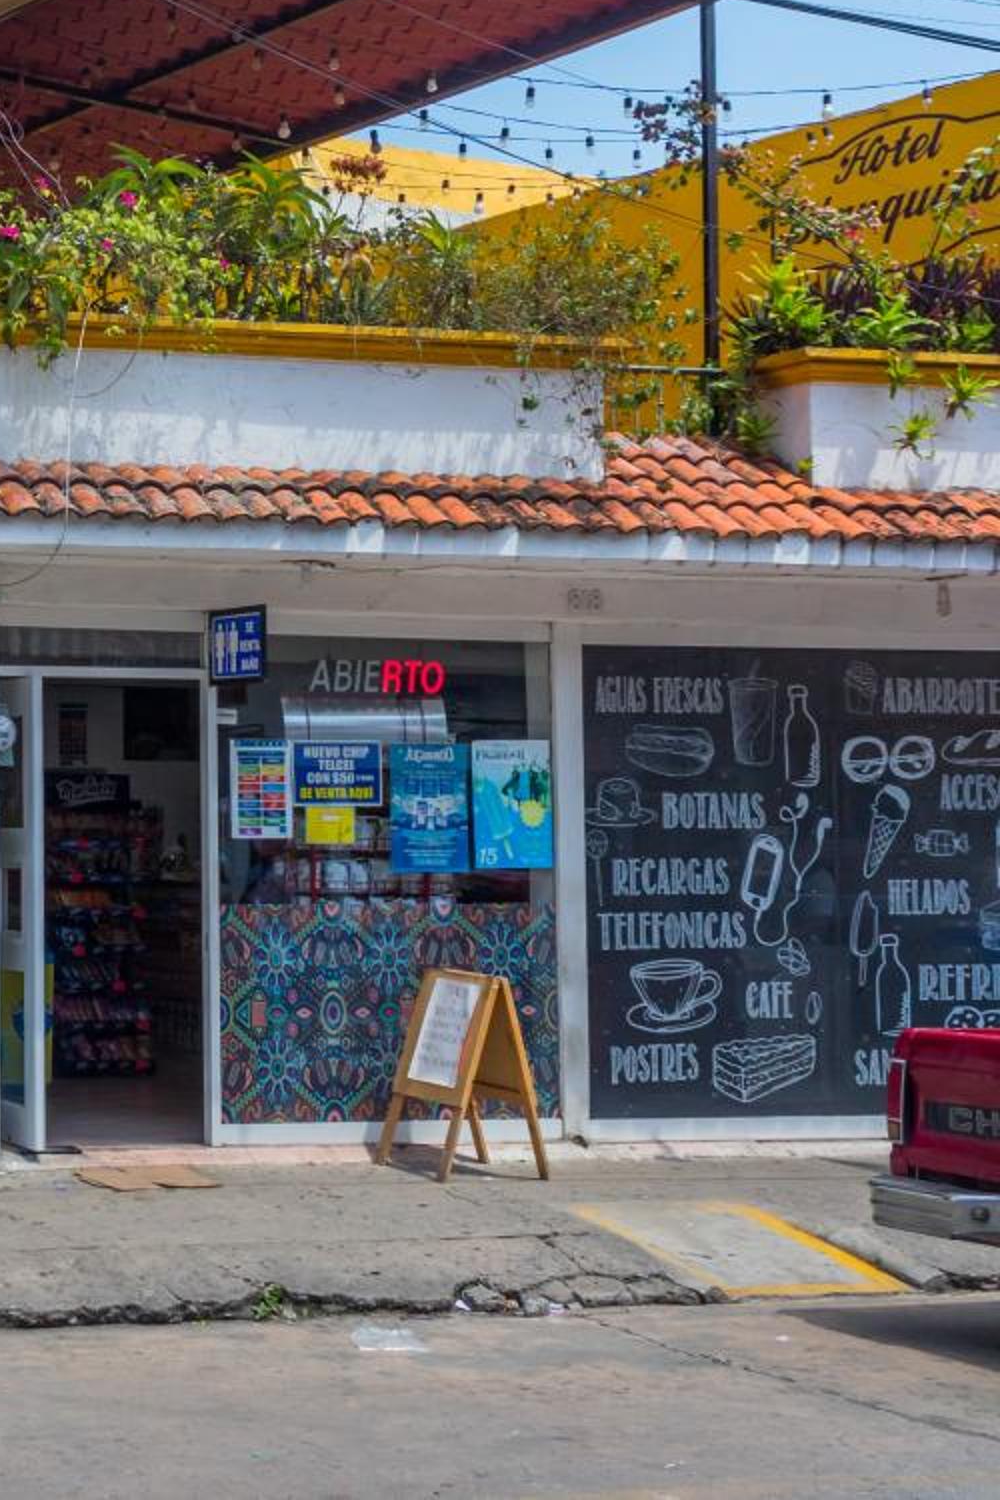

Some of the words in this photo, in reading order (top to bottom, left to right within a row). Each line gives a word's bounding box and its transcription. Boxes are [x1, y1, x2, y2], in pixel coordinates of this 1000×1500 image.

[834, 118, 946, 185] Hotel
[309, 659, 446, 694] ABIERTO
[595, 676, 647, 713] AGUAS
[653, 676, 724, 714] FRESCAS
[303, 745, 341, 759] NUEVO
[318, 759, 356, 771] TELCEL
[306, 771, 330, 785] CON
[332, 771, 355, 785] $50
[315, 786, 347, 800] VENTA
[661, 791, 767, 830] BOTANAS
[612, 857, 731, 897] RECARGAS
[887, 879, 971, 916] HELADOS
[597, 911, 748, 950] TELEFONICAS
[745, 981, 794, 1019] CAFE
[610, 1043, 699, 1085] POSTRES
